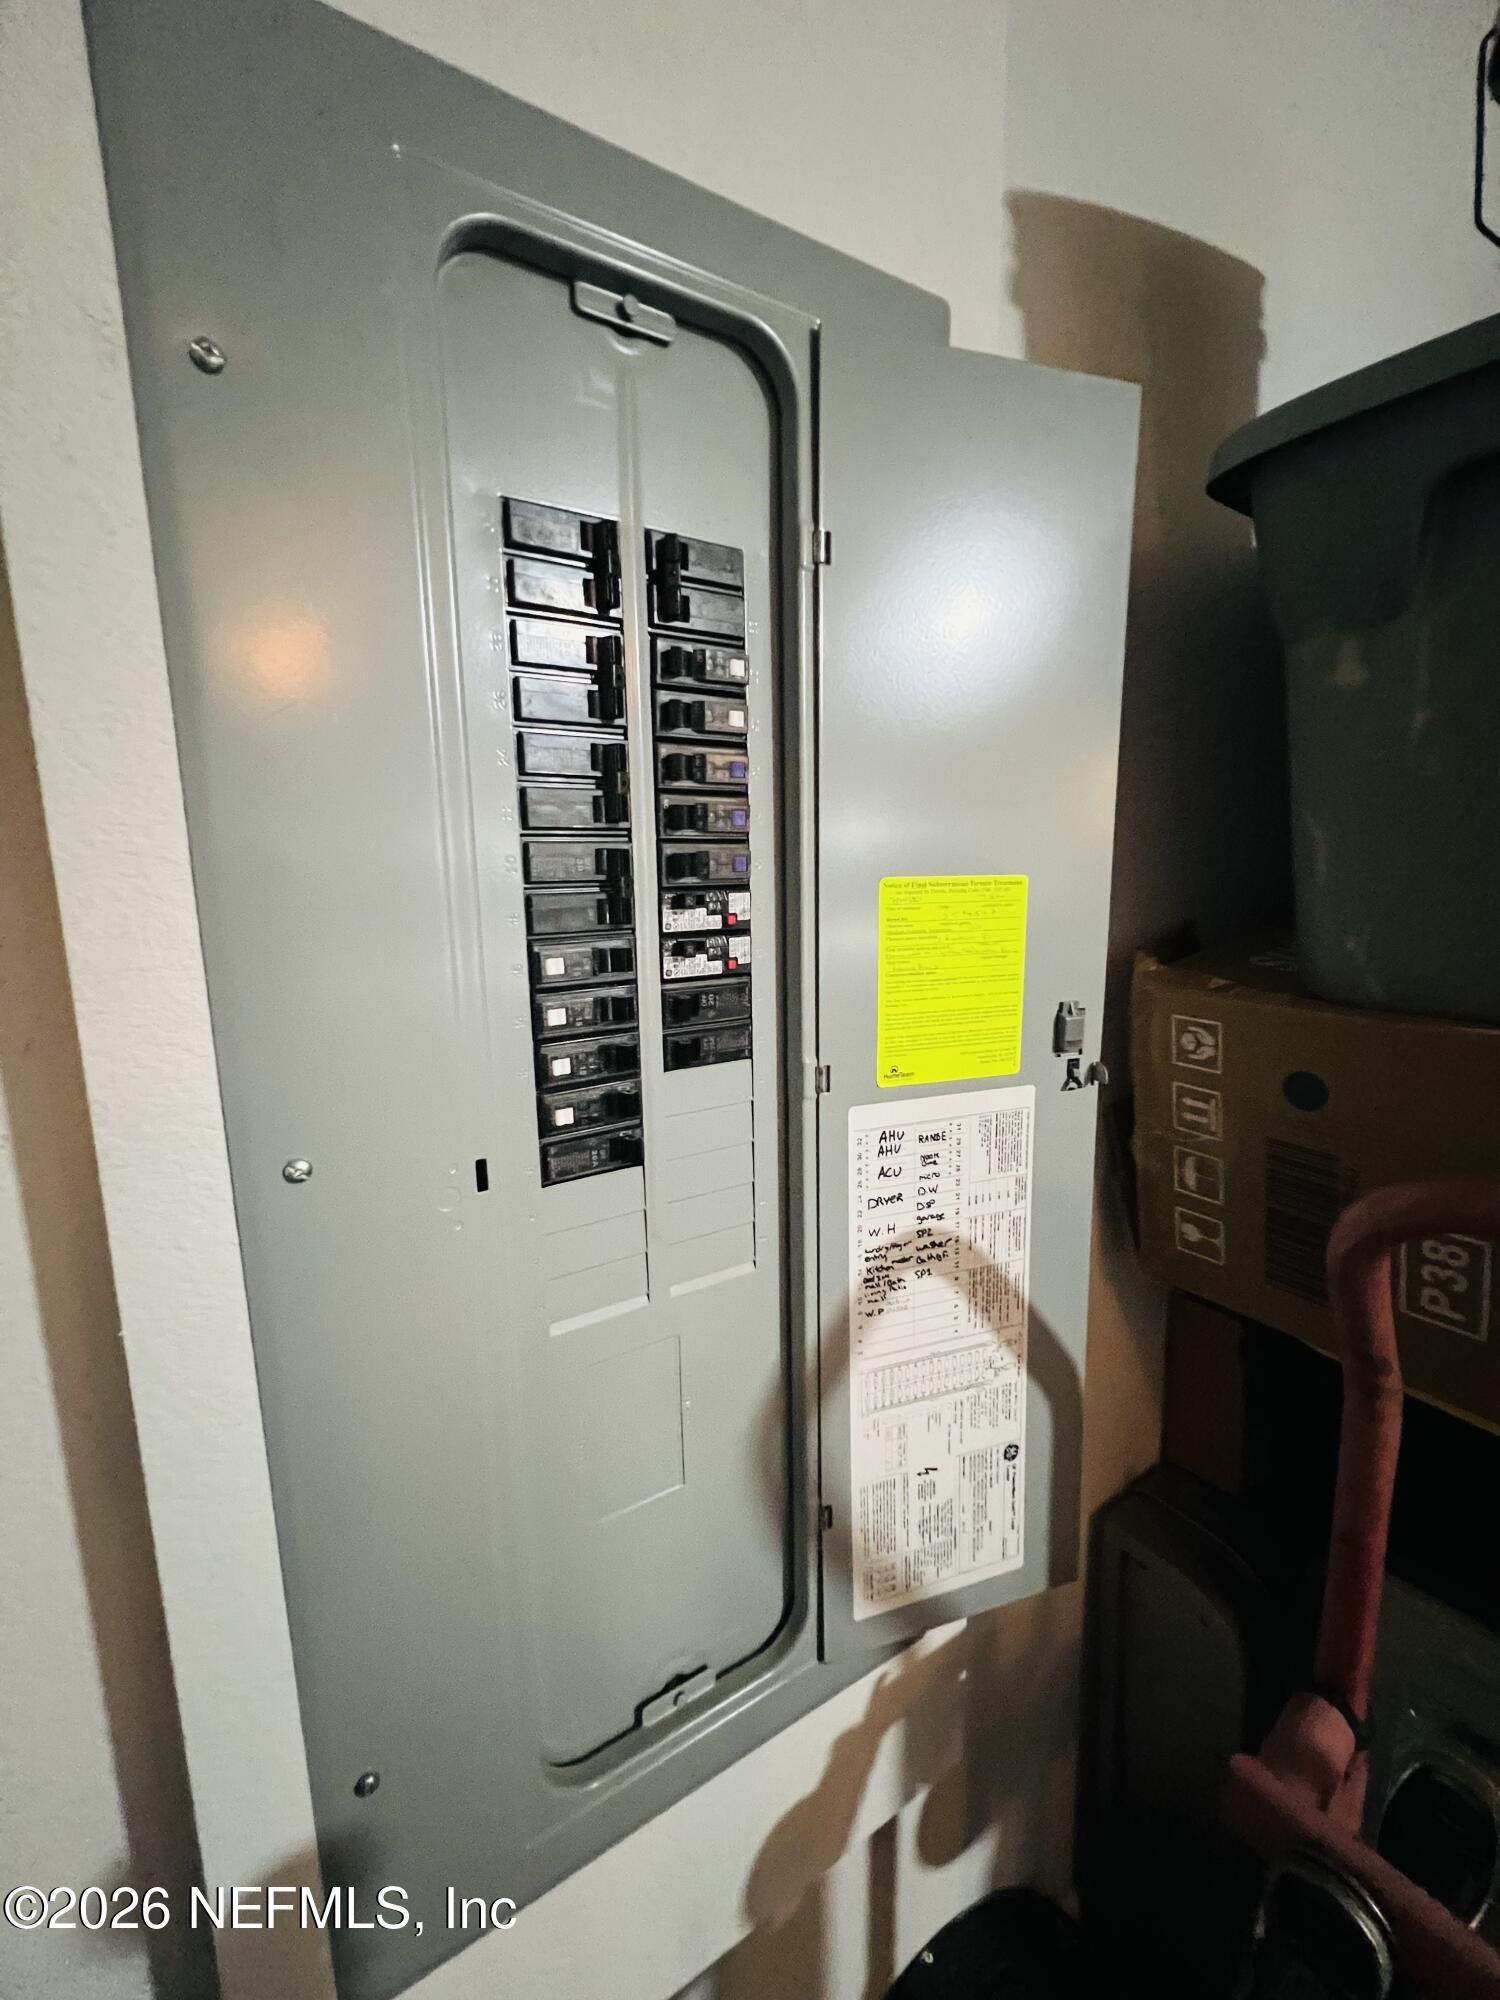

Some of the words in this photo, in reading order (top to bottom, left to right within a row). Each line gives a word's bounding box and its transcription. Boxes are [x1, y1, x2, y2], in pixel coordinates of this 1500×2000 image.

[879, 1130, 904, 1144] AHU
[878, 1144, 901, 1157] AHU
[1421, 1239, 1469, 1321] P38
